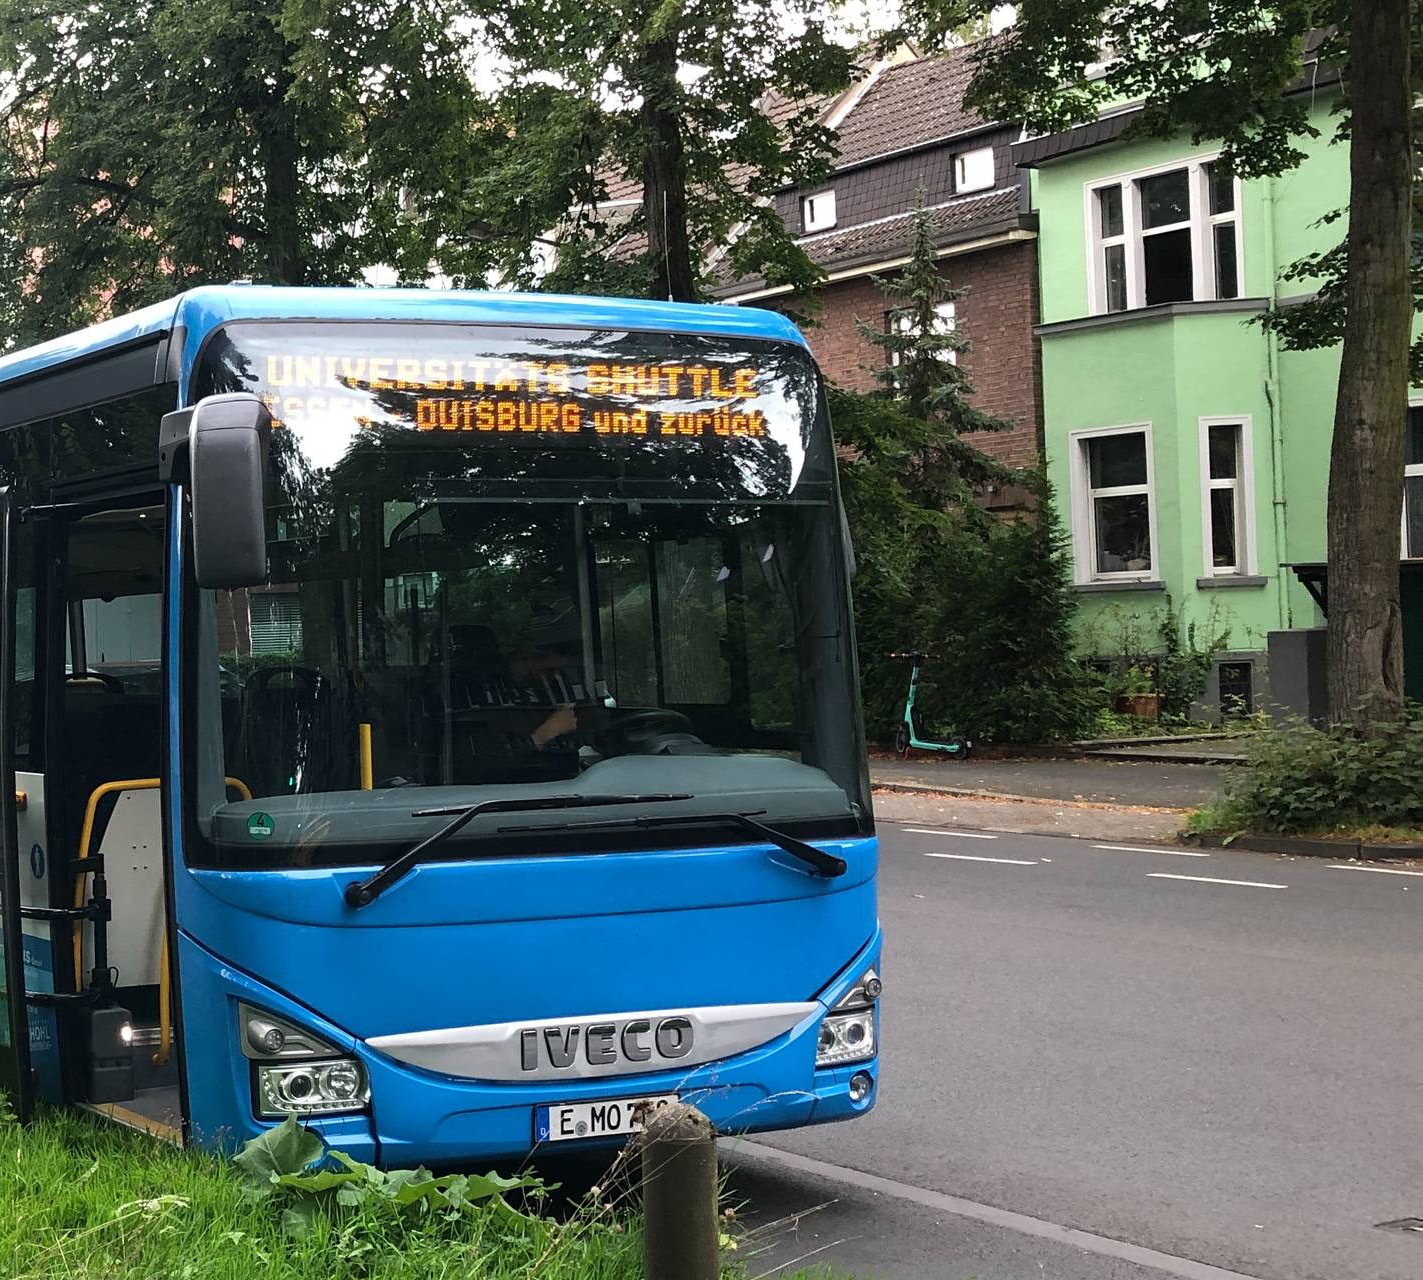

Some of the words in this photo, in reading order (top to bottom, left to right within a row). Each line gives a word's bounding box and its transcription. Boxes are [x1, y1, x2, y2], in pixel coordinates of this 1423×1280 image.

[267, 355, 570, 393] UNIVERSITÄTS
[587, 363, 757, 399] SHUTTLE
[416, 399, 581, 433] DUISBURG
[594, 405, 648, 435] und
[660, 405, 765, 437] zurück
[256, 814, 265, 826] 4
[521, 1016, 694, 1071] IVECO
[560, 1109, 574, 1135] E
[590, 1104, 622, 1137] MO
